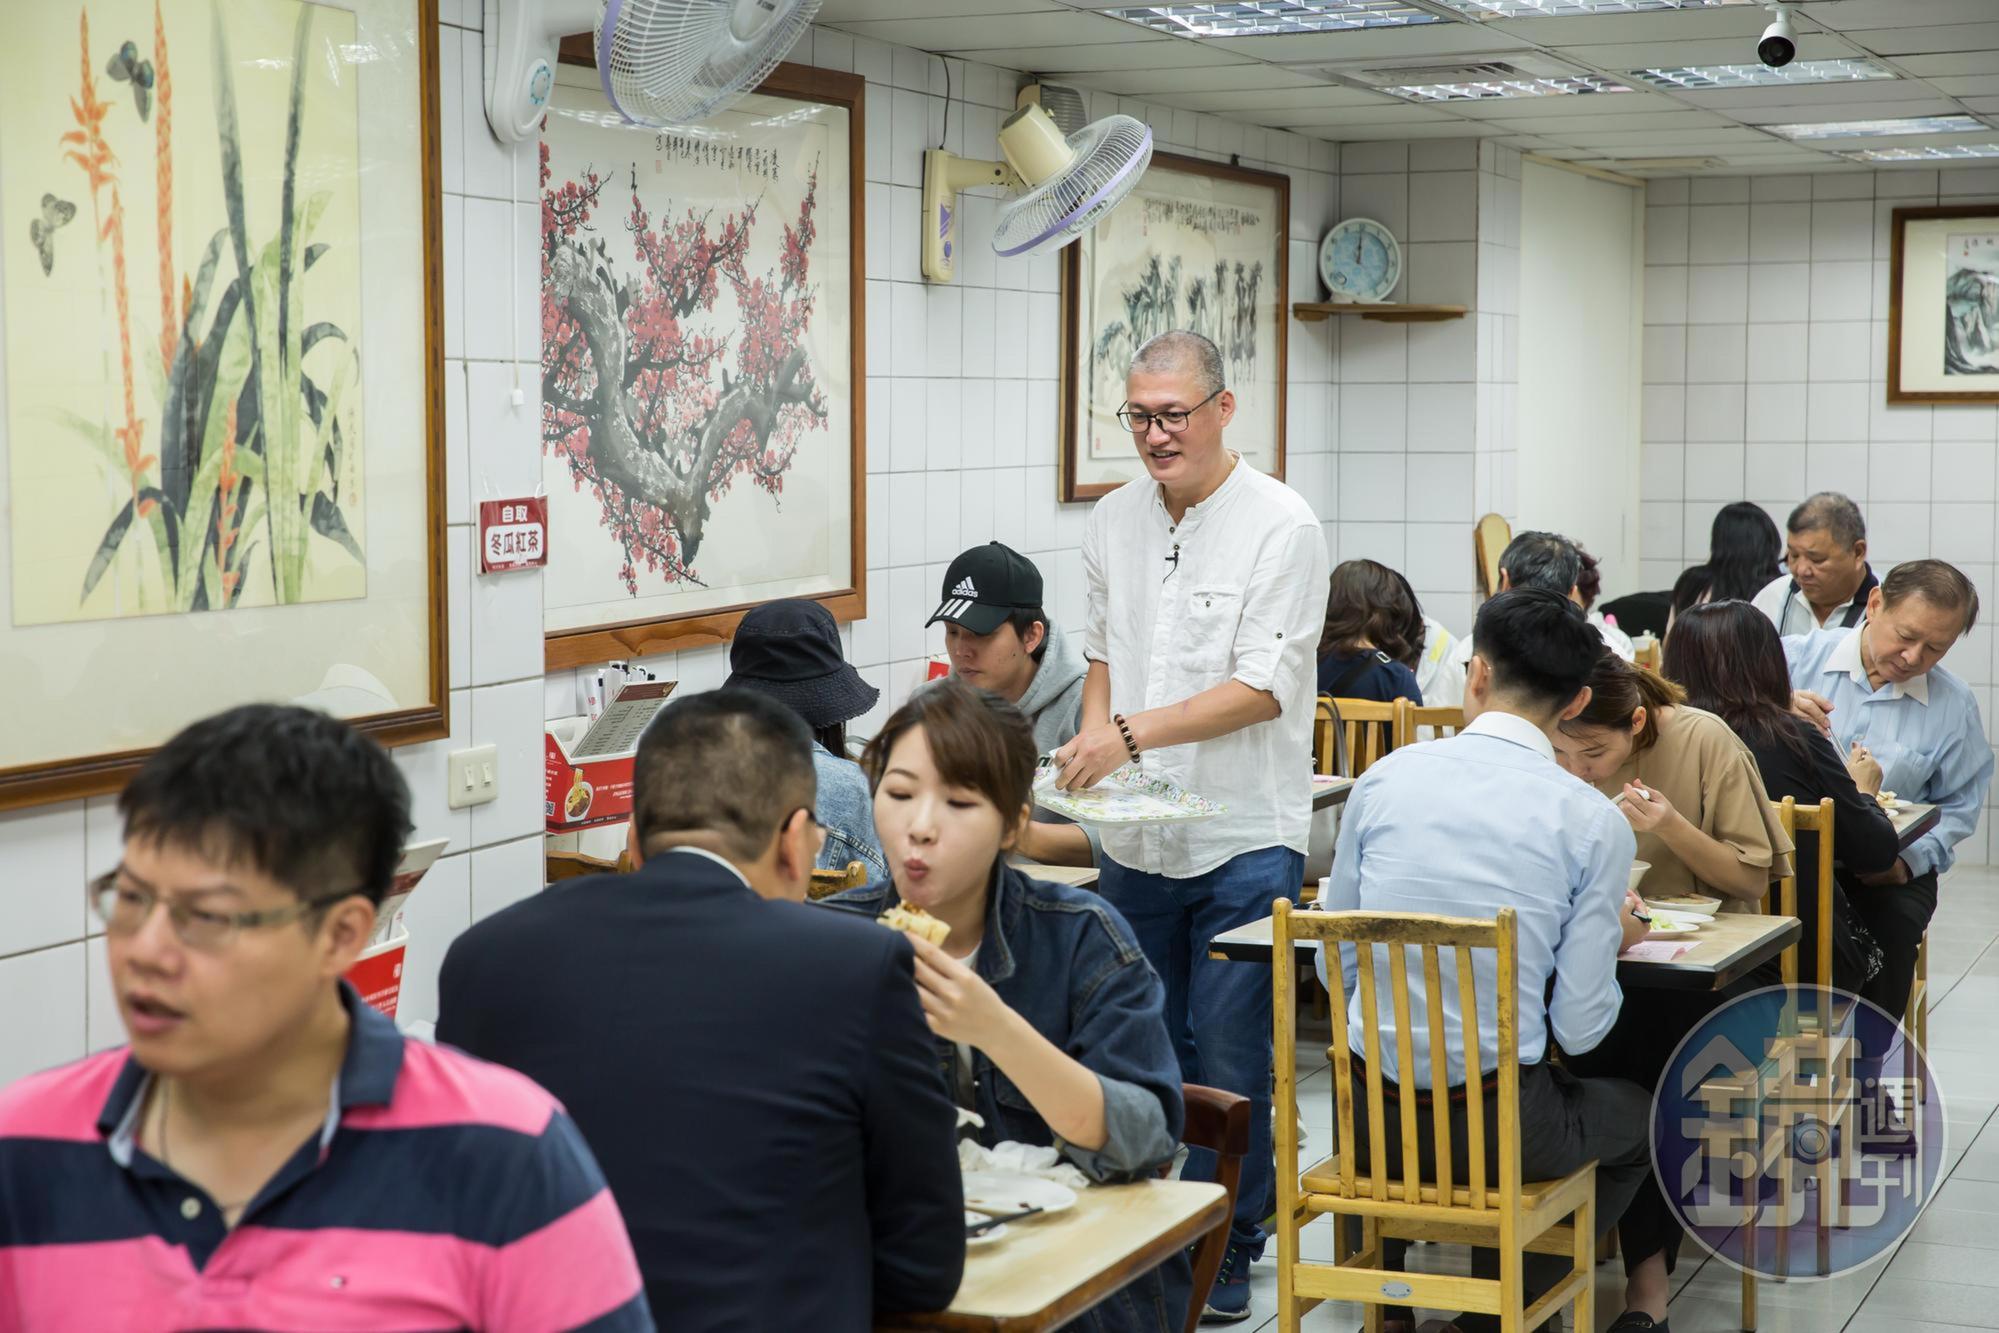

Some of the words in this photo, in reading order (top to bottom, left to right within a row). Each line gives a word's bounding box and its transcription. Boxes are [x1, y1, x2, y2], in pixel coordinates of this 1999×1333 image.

[502, 505, 528, 522] 自取
[491, 530, 538, 556] 冬瓜紅茶
[952, 588, 978, 598] adidas
